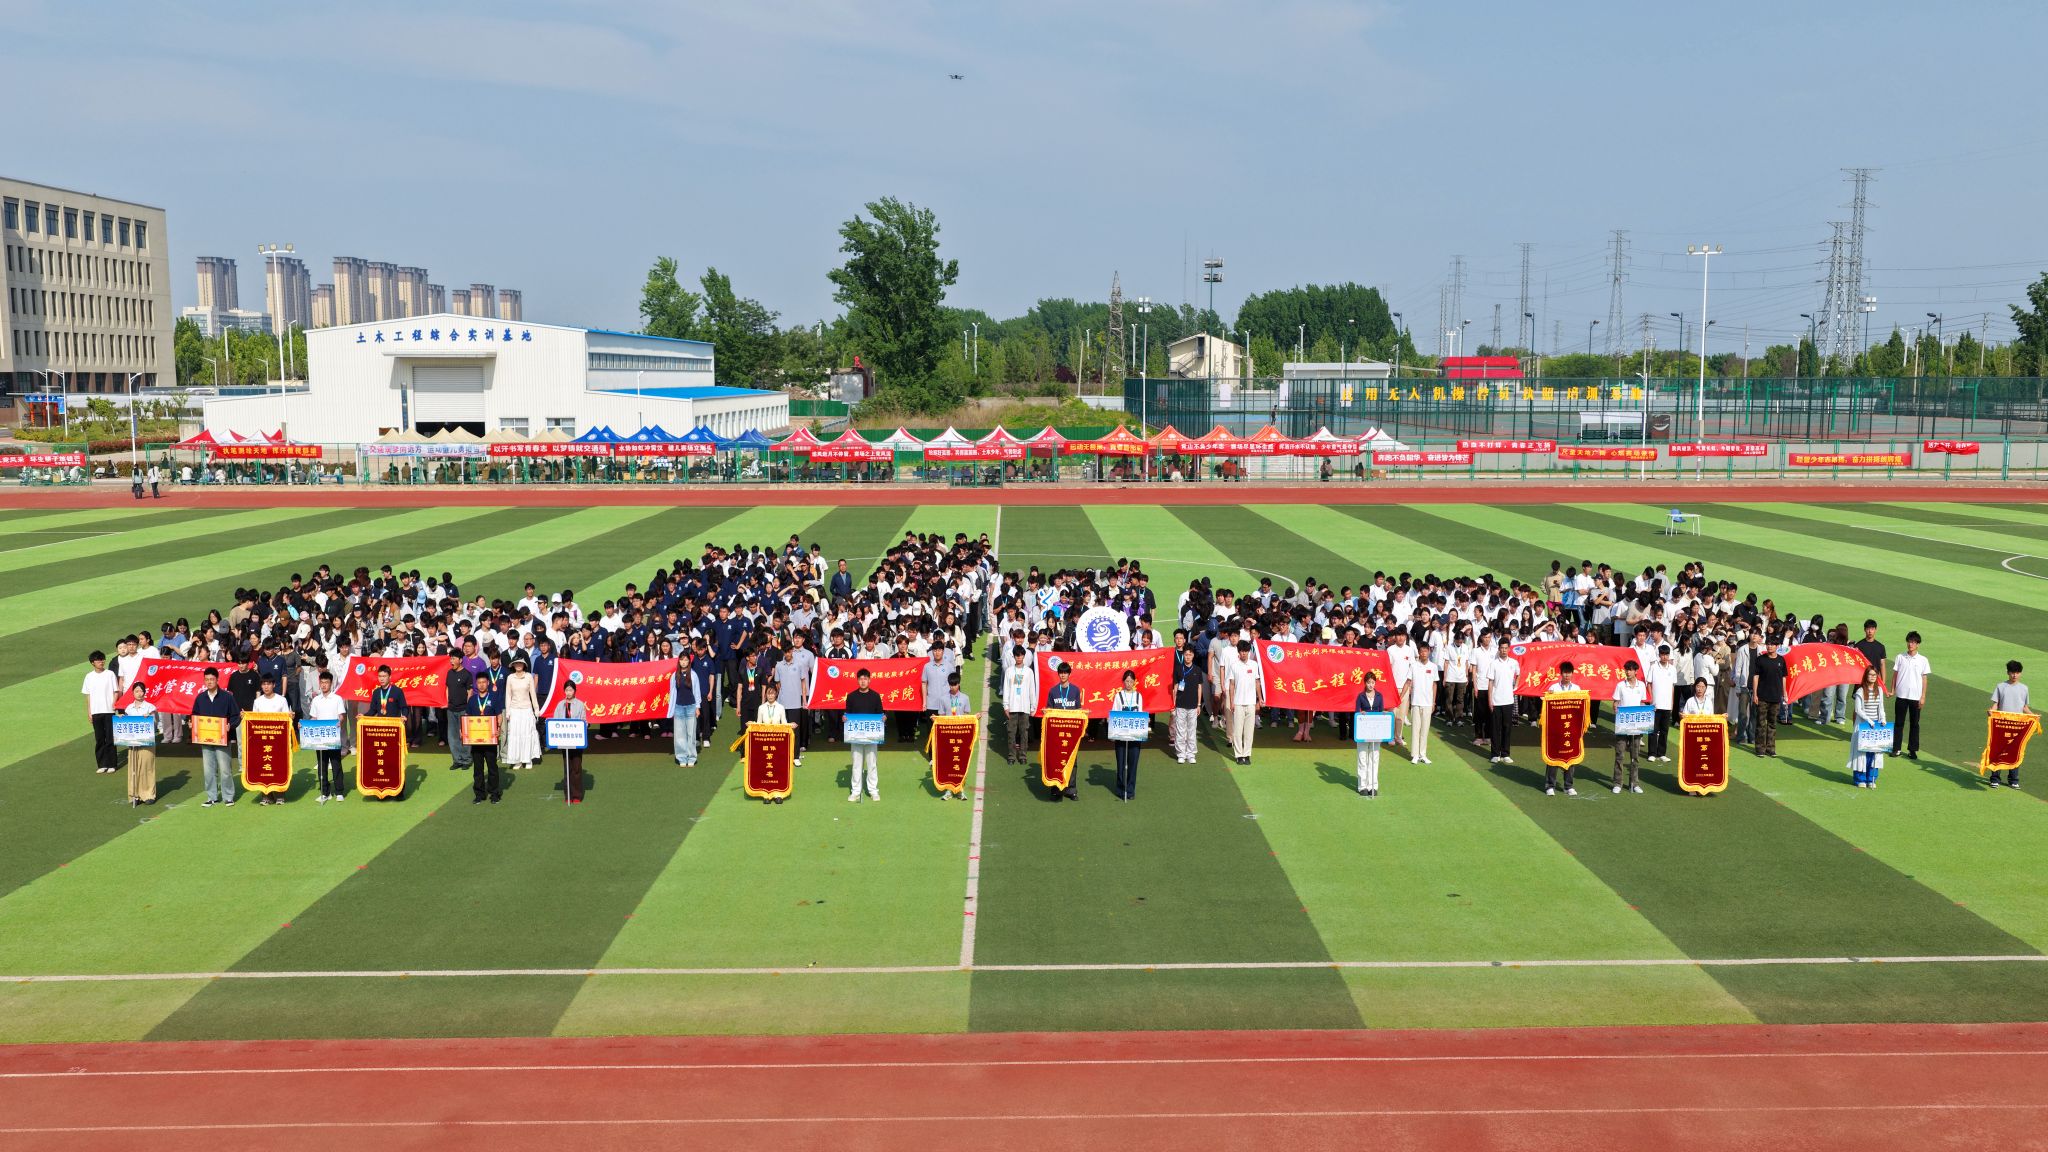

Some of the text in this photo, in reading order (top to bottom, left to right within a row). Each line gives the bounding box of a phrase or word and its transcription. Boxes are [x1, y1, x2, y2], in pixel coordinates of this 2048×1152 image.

[356, 327, 532, 344] 土木工程综合实训基地
[1273, 666, 1387, 695] 交通工程学院
[1525, 662, 1628, 688] 信息程学院
[1112, 717, 1145, 730] 水利工程学院
[1619, 712, 1652, 724] 信息工程学院
[116, 722, 151, 734] 经济管理学院
[303, 725, 337, 738] 机电工程学院
[847, 720, 883, 733] 土木工程学院
[262, 744, 273, 771] 第六名
[1700, 744, 1709, 771] 第二名
